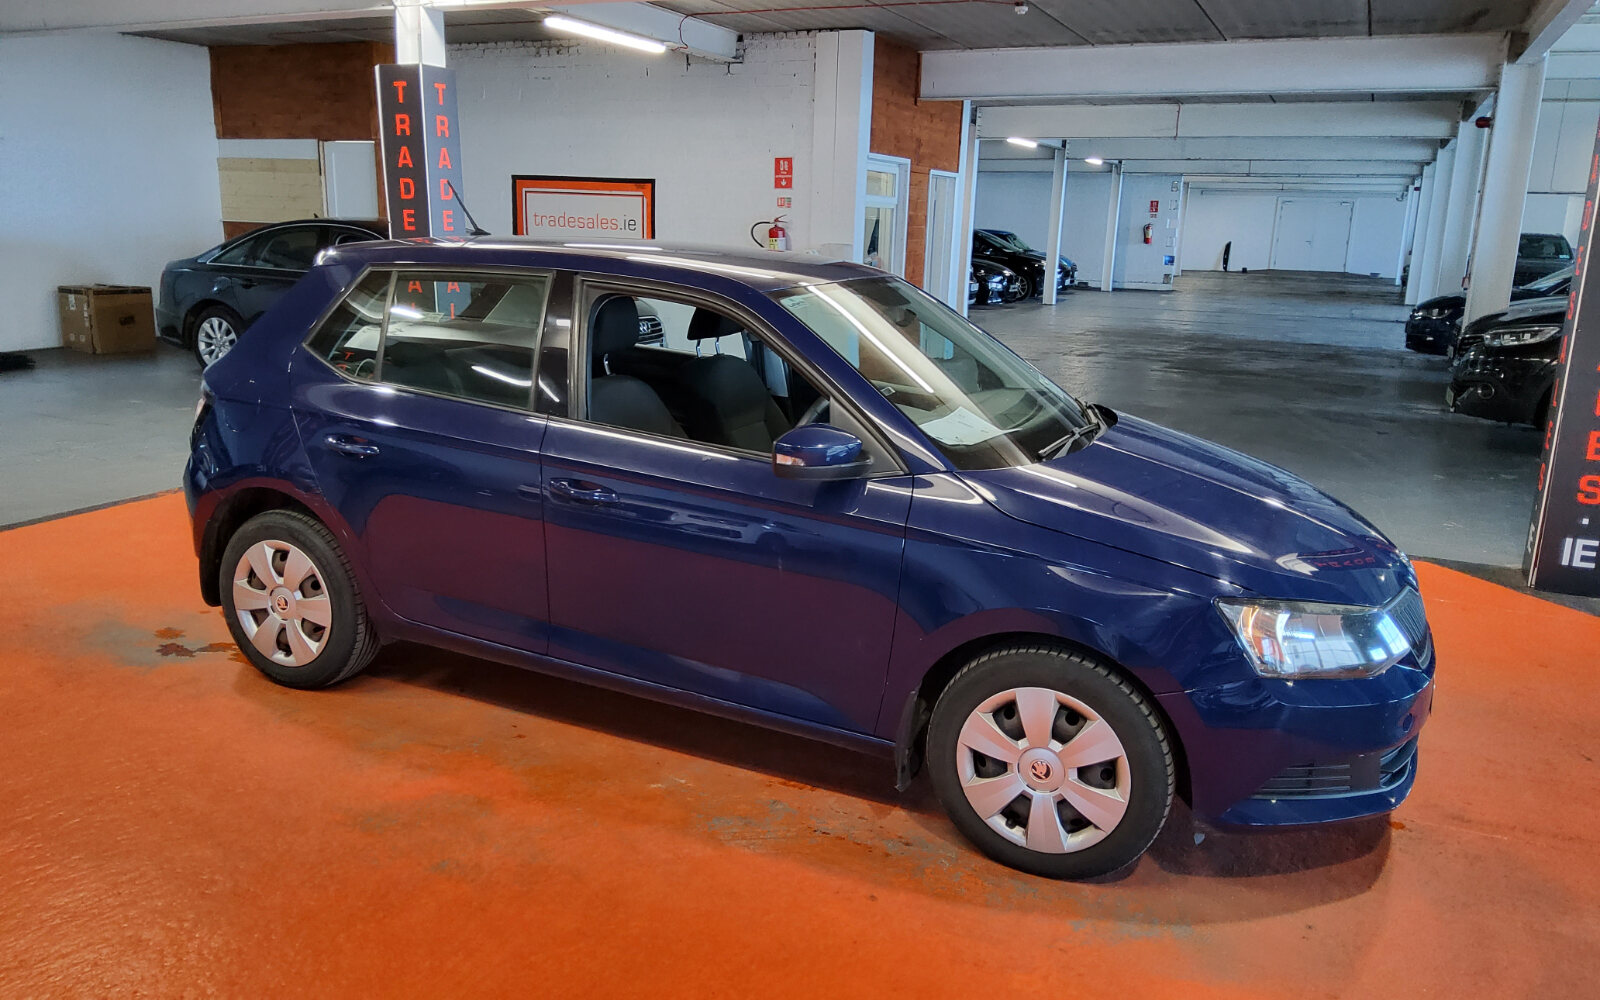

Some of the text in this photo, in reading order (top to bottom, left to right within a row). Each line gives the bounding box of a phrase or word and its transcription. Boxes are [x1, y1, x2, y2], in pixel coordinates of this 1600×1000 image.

[393, 80, 416, 231] TRADE
[434, 83, 454, 231] TRADE
[533, 211, 637, 232] tradesales.ie
